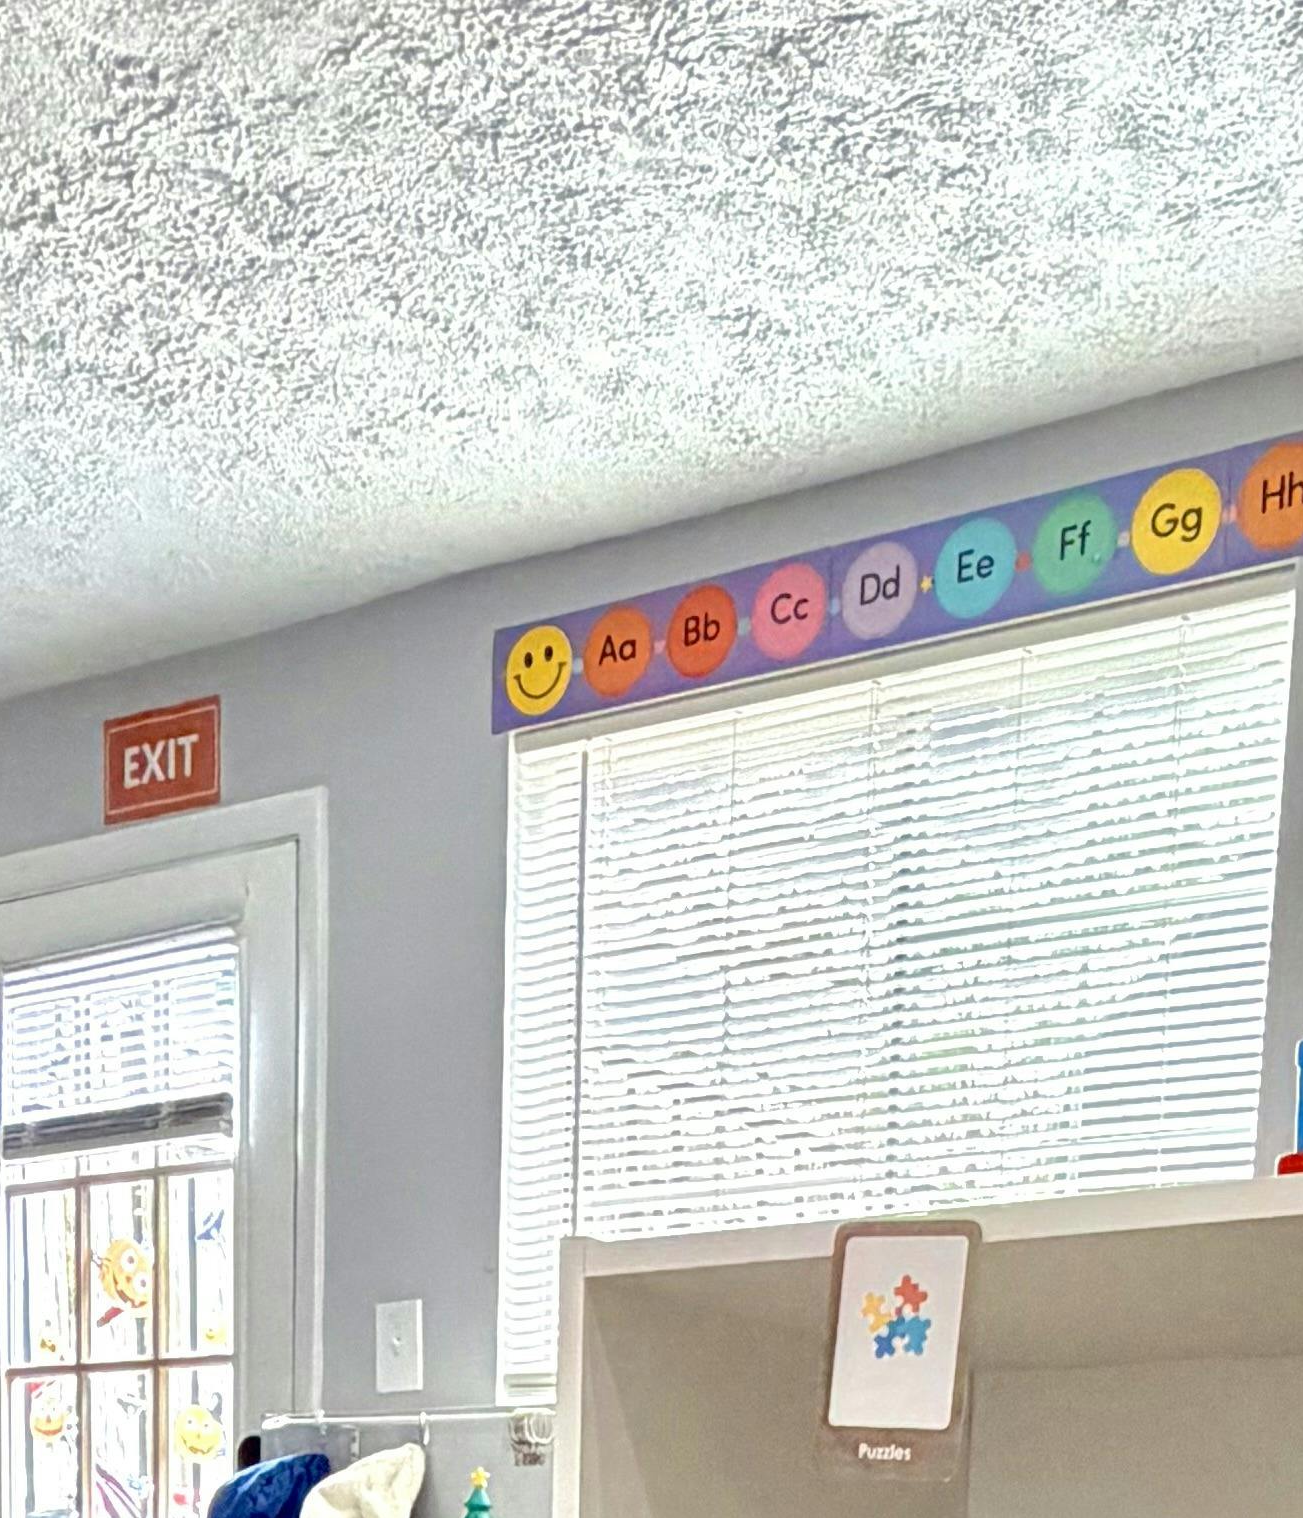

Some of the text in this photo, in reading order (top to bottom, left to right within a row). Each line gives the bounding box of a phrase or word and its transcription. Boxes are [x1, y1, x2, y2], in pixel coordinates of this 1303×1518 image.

[597, 633, 638, 667] Aa
[682, 611, 721, 648] Bb
[769, 591, 810, 626] Cc
[859, 563, 901, 607] Dd
[956, 548, 996, 584] Ee
[1059, 518, 1092, 562] Ff
[1149, 501, 1205, 544] Gg
[122, 733, 200, 789] EXIT
[857, 1442, 912, 1462] Puzzles
